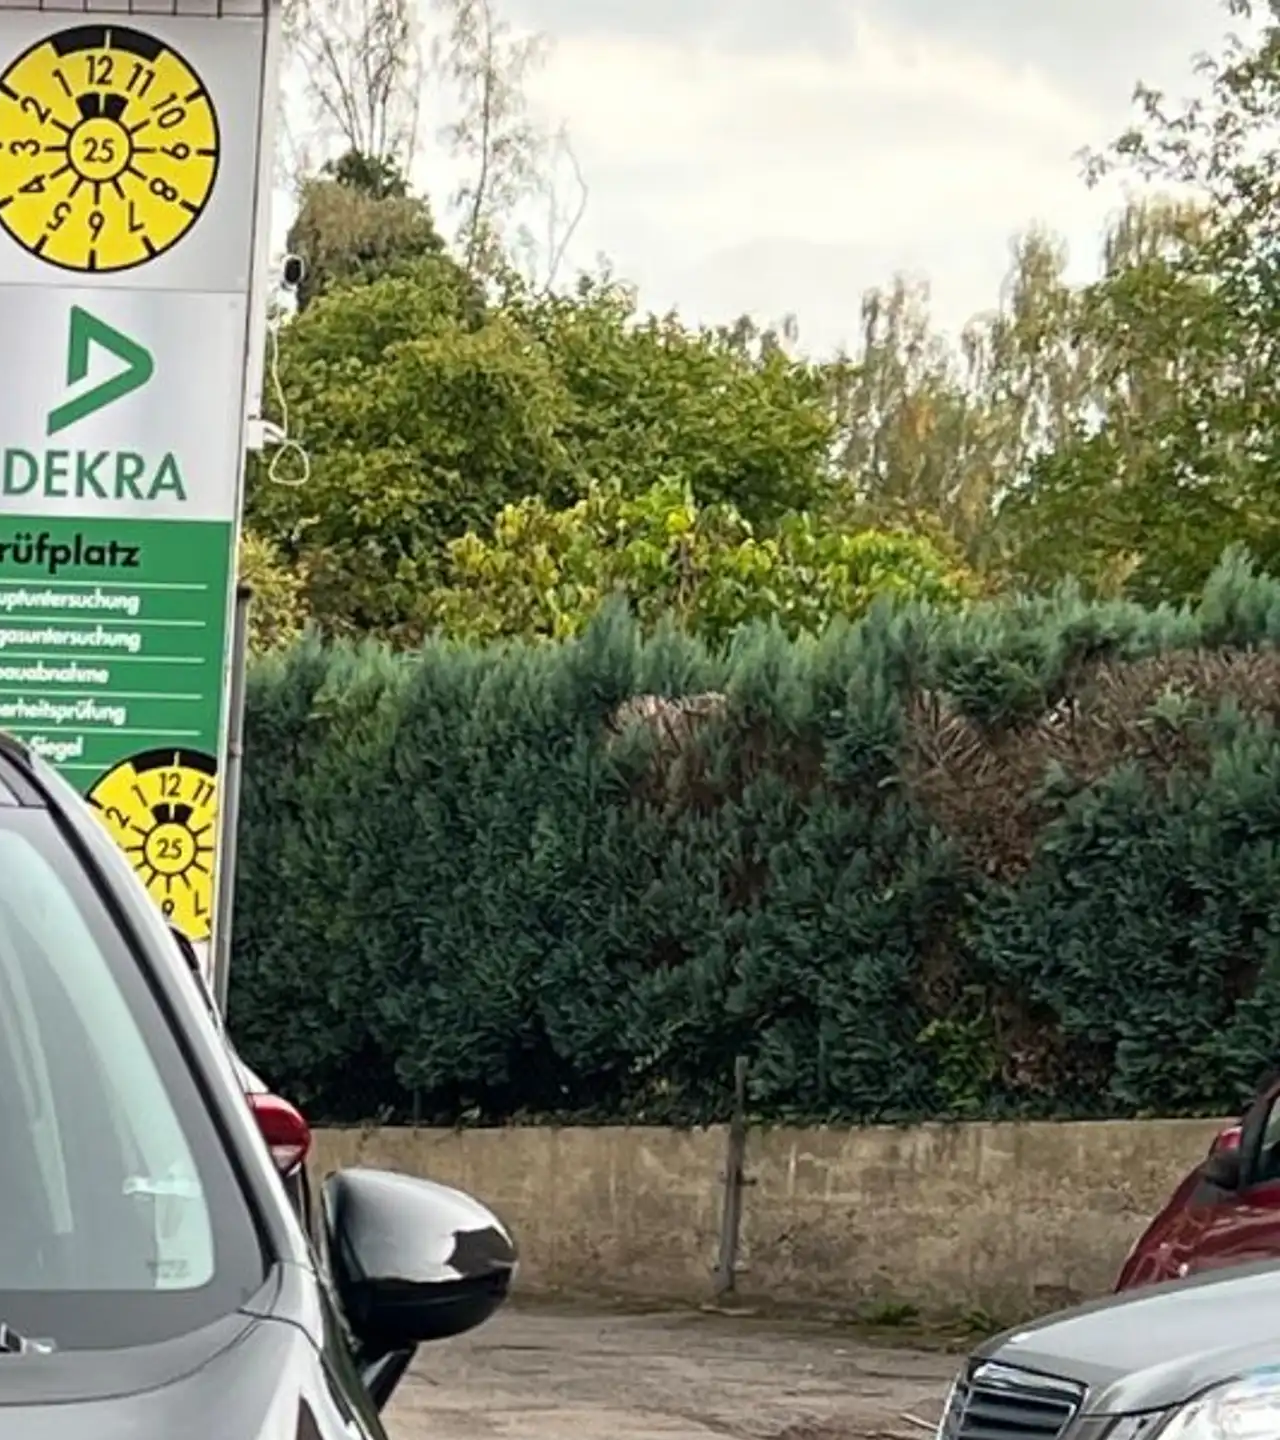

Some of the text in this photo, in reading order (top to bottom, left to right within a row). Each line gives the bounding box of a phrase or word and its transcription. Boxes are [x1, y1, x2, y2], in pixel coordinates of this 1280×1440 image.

[52, 69, 72, 97] 1
[86, 56, 113, 85] 12
[126, 62, 156, 97] 11
[20, 96, 52, 124] 2
[150, 92, 186, 129] 10
[10, 139, 40, 157] 3
[83, 137, 115, 163] 25
[18, 175, 46, 193] 4
[150, 178, 178, 201] 8
[47, 202, 71, 231] 5
[2, 448, 187, 501] DEKRA
[131, 784, 148, 808] 1
[158, 773, 182, 798] 12
[192, 778, 215, 808] 11
[105, 806, 131, 829] 2
[155, 837, 183, 860] 25
